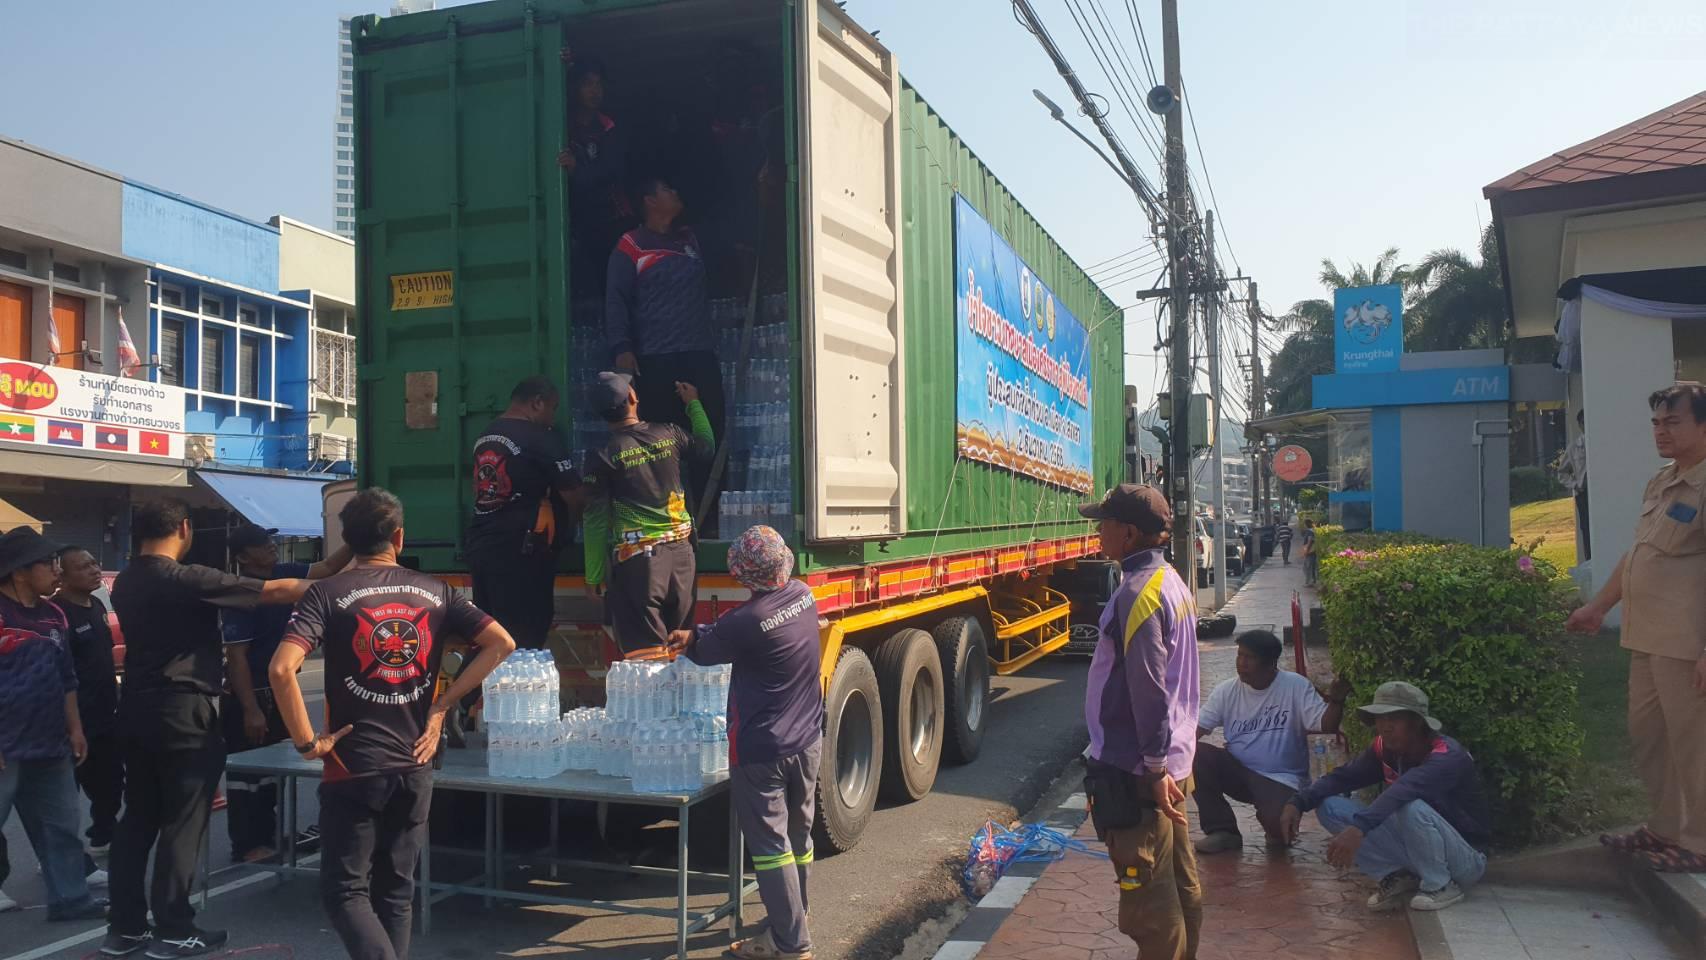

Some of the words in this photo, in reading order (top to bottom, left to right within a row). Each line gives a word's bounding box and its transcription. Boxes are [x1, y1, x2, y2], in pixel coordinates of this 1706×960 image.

[398, 274, 452, 294] CAUTION
[1343, 348, 1394, 361] Krungthai
[15, 378, 55, 400] MOU
[1451, 376, 1499, 396] ATM
[93, 393, 153, 412] รับทำเอกสาร
[377, 666, 416, 678] FIREFIGHTER
